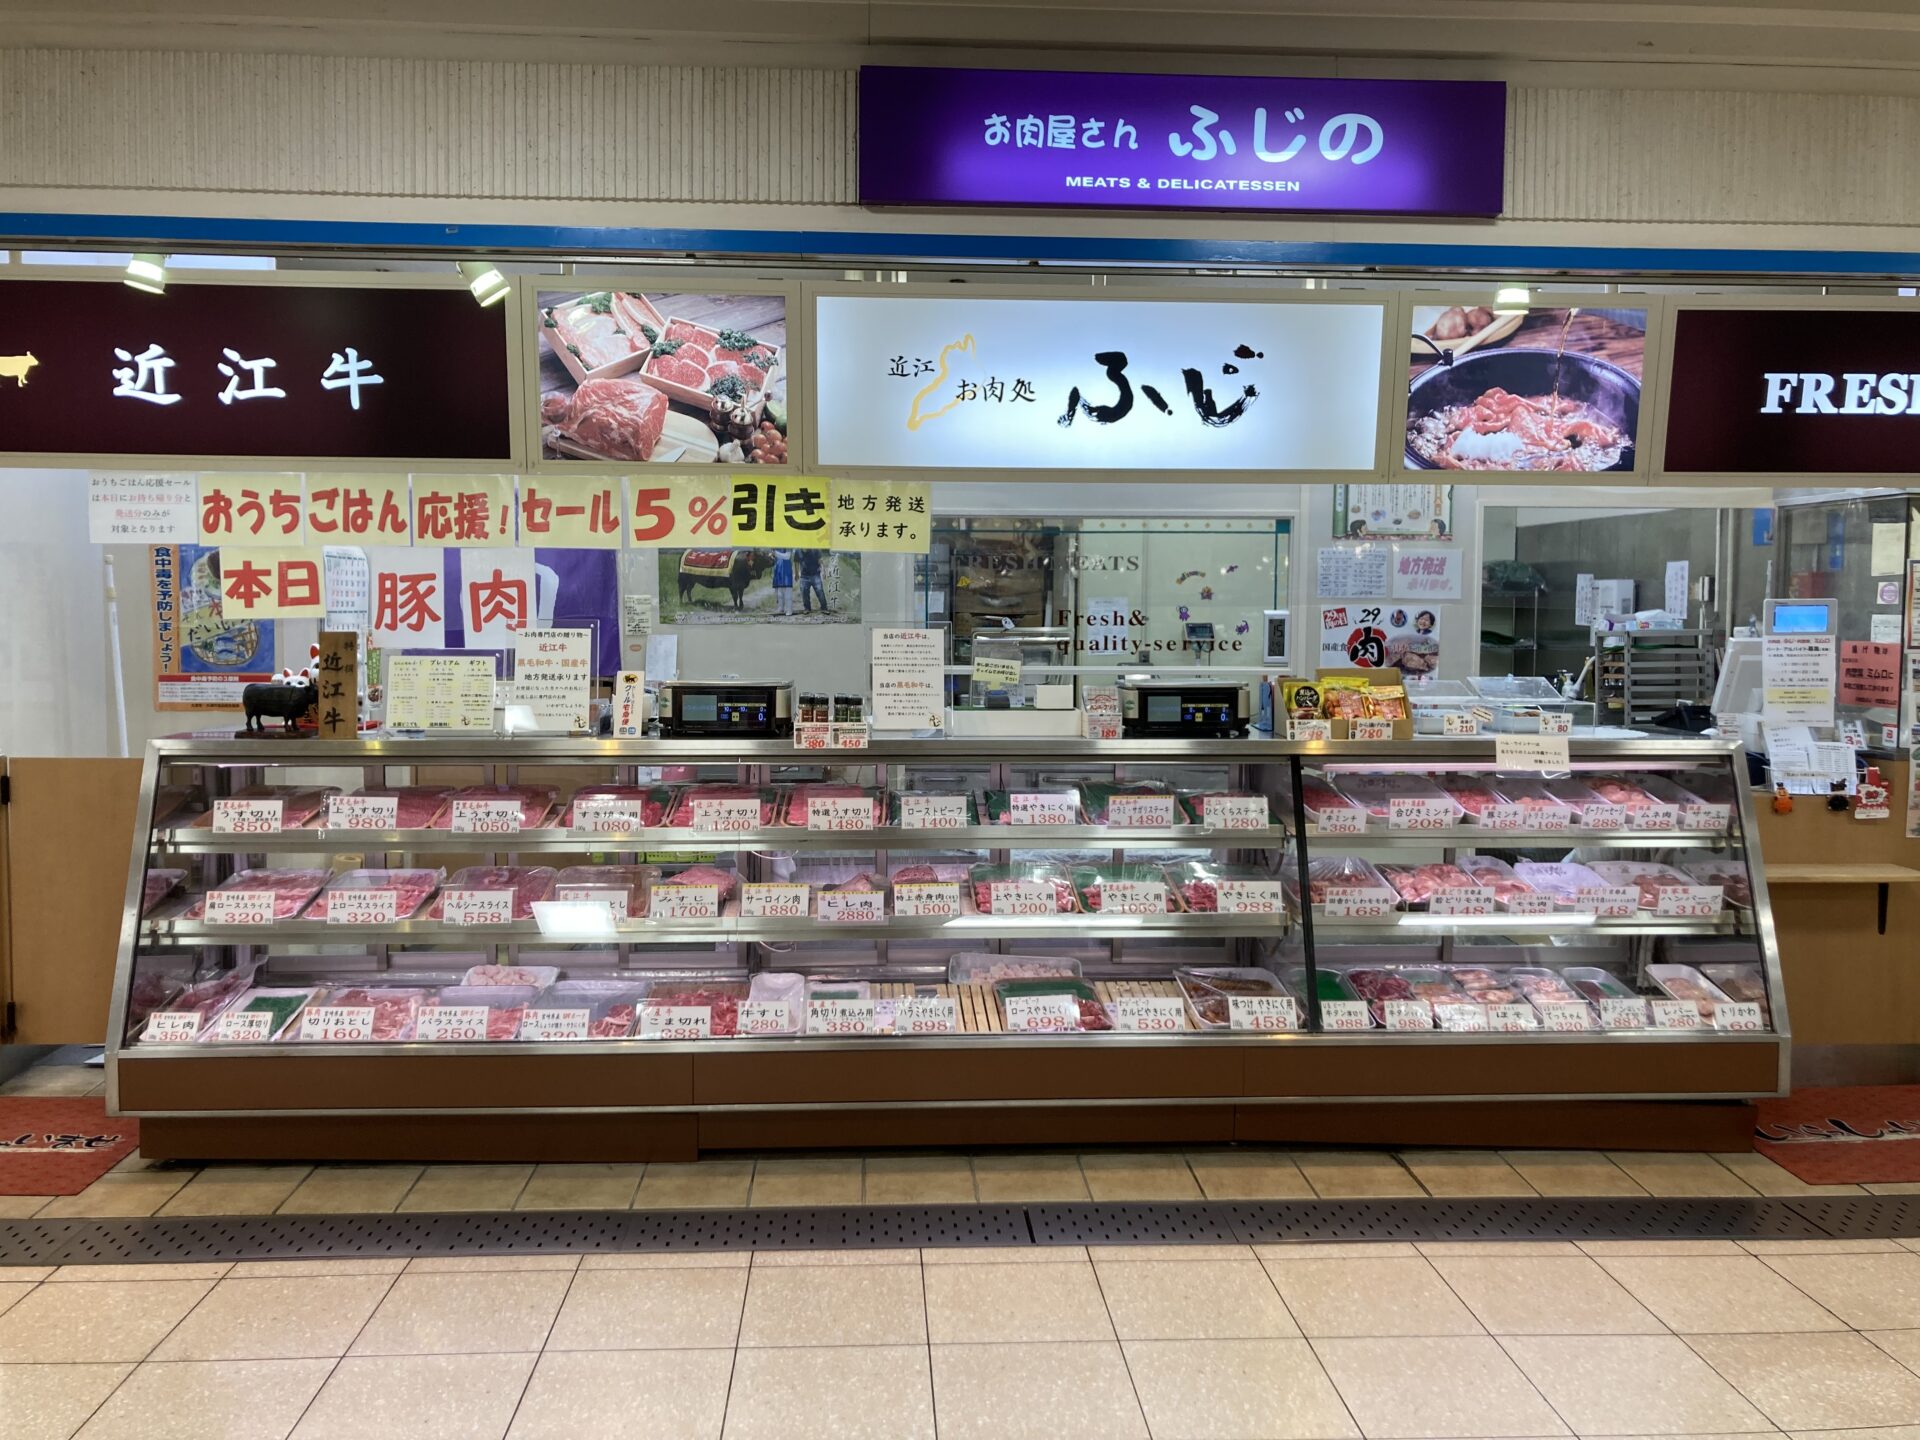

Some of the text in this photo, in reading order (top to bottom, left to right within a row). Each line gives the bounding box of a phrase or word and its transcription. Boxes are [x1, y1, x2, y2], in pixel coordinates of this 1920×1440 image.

[984, 105, 1383, 164] お肉屋さん ふじの
[1066, 176, 1300, 192] MEATS & DELICATESSEN
[889, 356, 935, 378] 近江
[111, 342, 385, 410] 近江牛
[956, 377, 1036, 402] お肉処
[1057, 344, 1264, 427] ふじ
[838, 494, 925, 513] 地方発送
[112, 525, 175, 533] 対象となります
[840, 522, 916, 540] 承ります。
[1398, 557, 1447, 575] 地方発送
[224, 561, 320, 608] 本日
[1360, 608, 1380, 623] 29
[539, 643, 567, 652] 近江牛
[322, 652, 345, 733] 近江牛
[221, 810, 277, 818] うす切り
[702, 809, 758, 817] 上うす切り
[812, 809, 870, 817] 特選うす切り
[908, 807, 962, 816] ローストビーフ
[1396, 809, 1451, 817] 合びきミンチ
[746, 895, 800, 904] サーロイン肉
[1108, 893, 1162, 901] やきにく用
[900, 1008, 953, 1017] ハラミやきにく用
[1721, 1008, 1756, 1017] トリかわ
[157, 1021, 195, 1029] ヒレ肉
